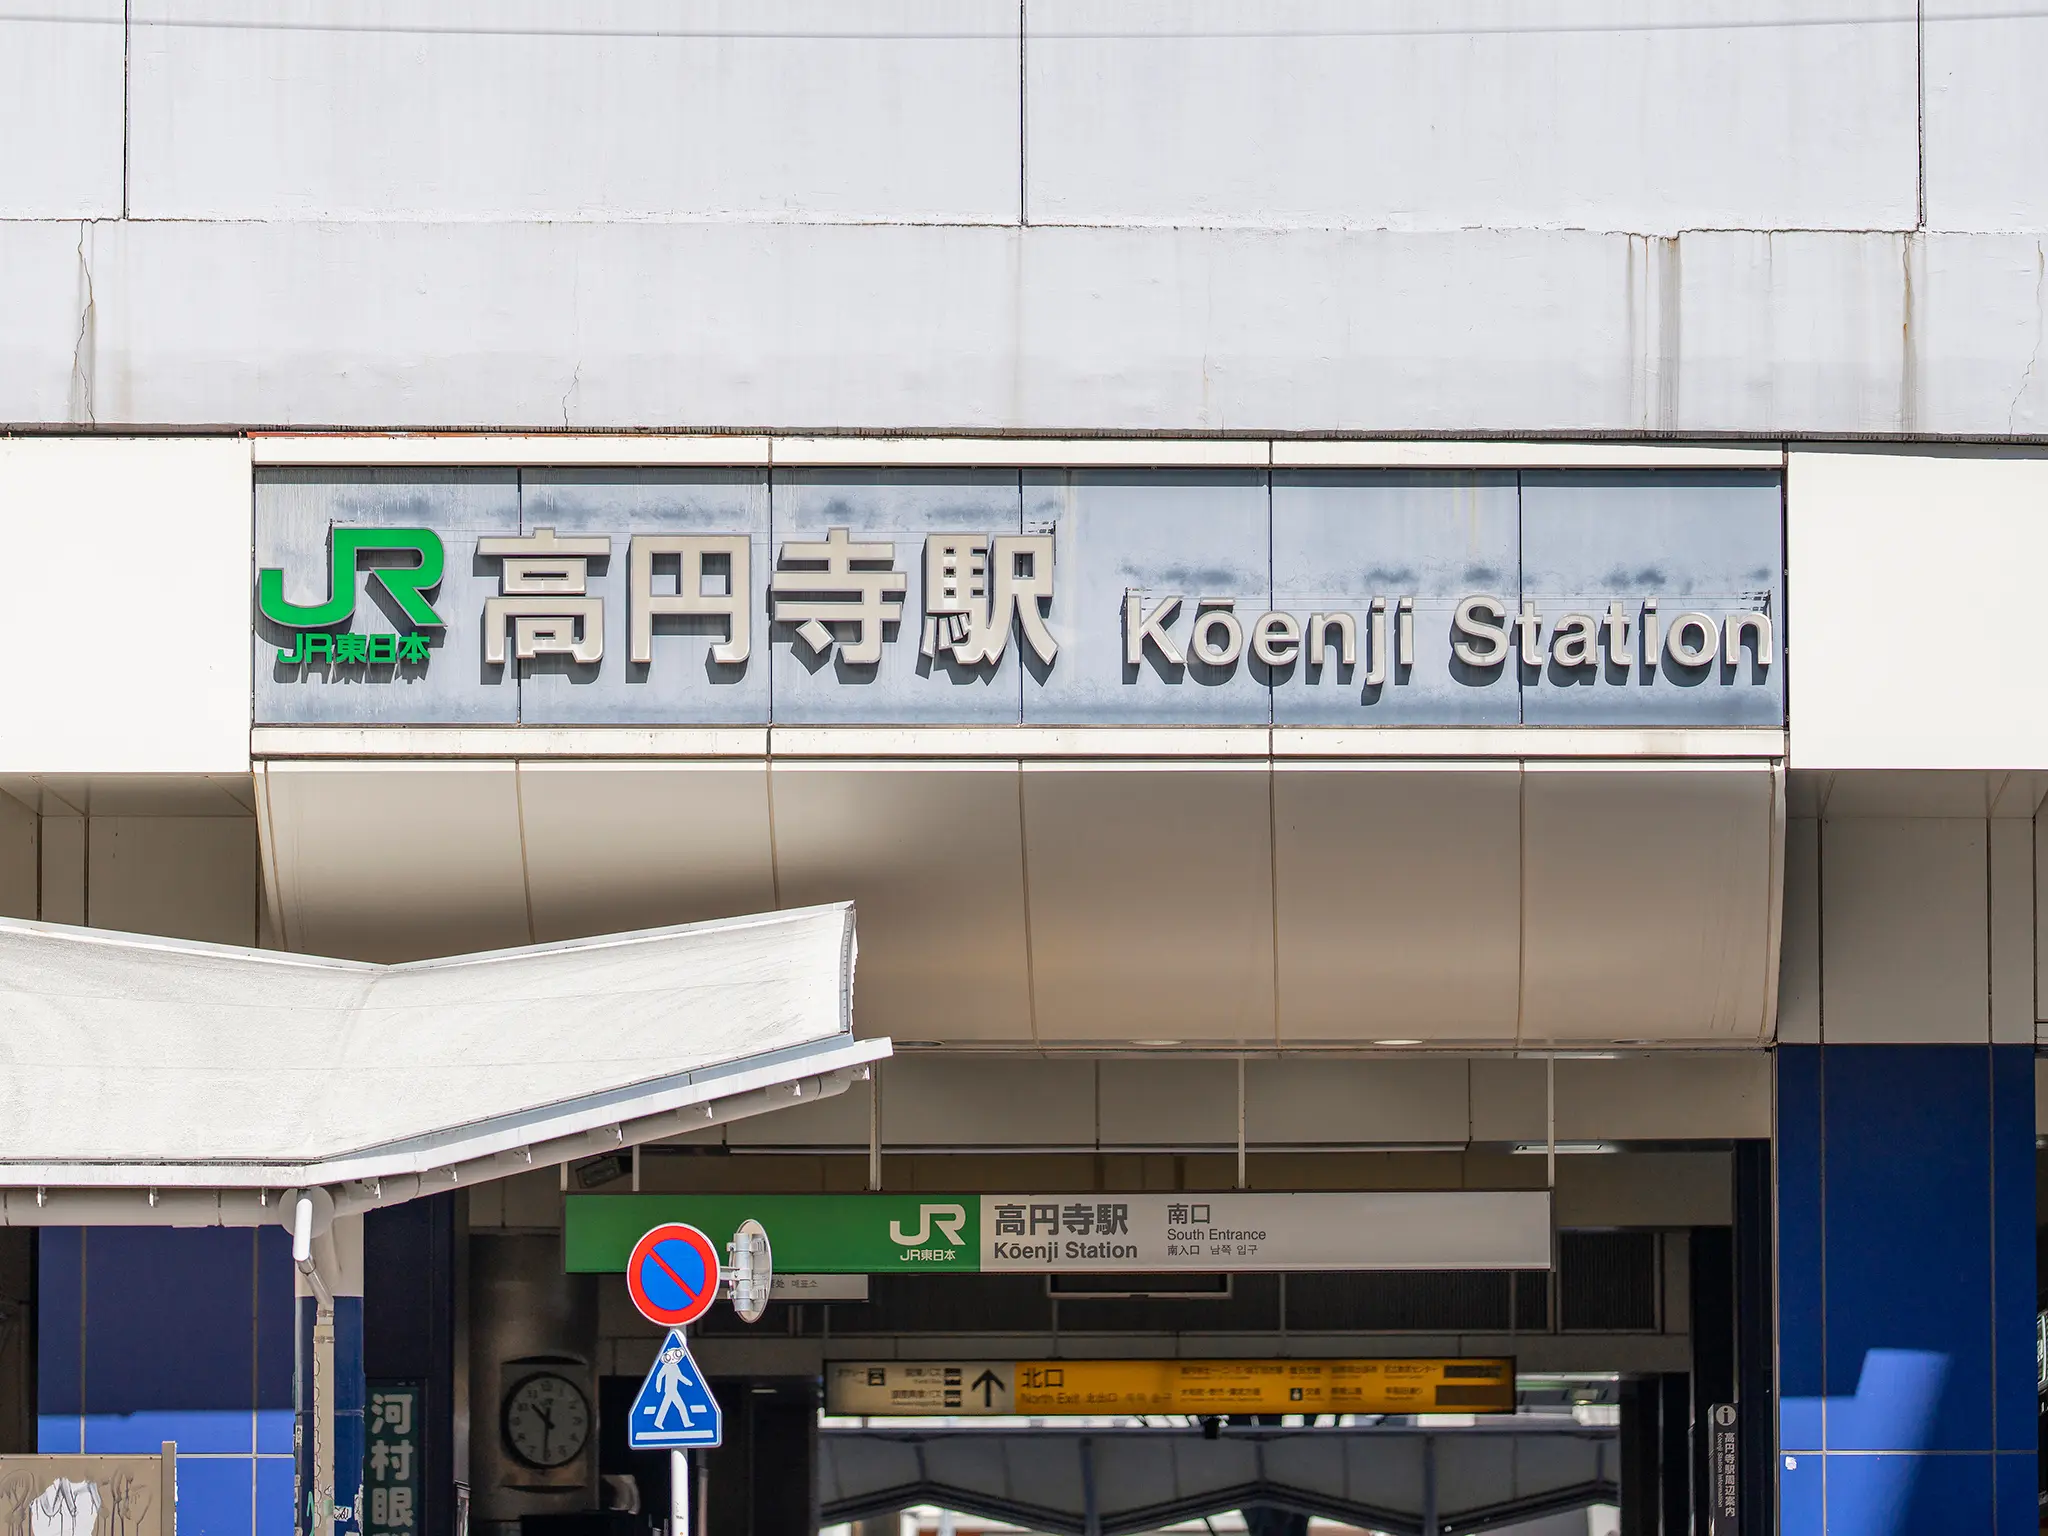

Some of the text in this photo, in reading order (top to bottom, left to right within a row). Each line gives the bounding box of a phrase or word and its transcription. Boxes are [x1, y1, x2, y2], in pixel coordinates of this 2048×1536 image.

[259, 527, 448, 628] JR
[477, 527, 1060, 665] 高円寺駅
[277, 632, 431, 664] JR東日本
[1128, 595, 1772, 685] Kōenji Station
[890, 1204, 967, 1246] JR
[994, 1203, 1129, 1236] 高円寺駅
[1167, 1203, 1210, 1225] 南口
[1167, 1228, 1267, 1241] South Entrance
[1167, 1244, 1258, 1256] 南入口 남쪽 입구
[900, 1249, 956, 1261] JR東日本
[994, 1241, 1138, 1263] Kōenji Station
[1021, 1368, 1064, 1388] 北口
[371, 1394, 414, 1536] 河村眼
